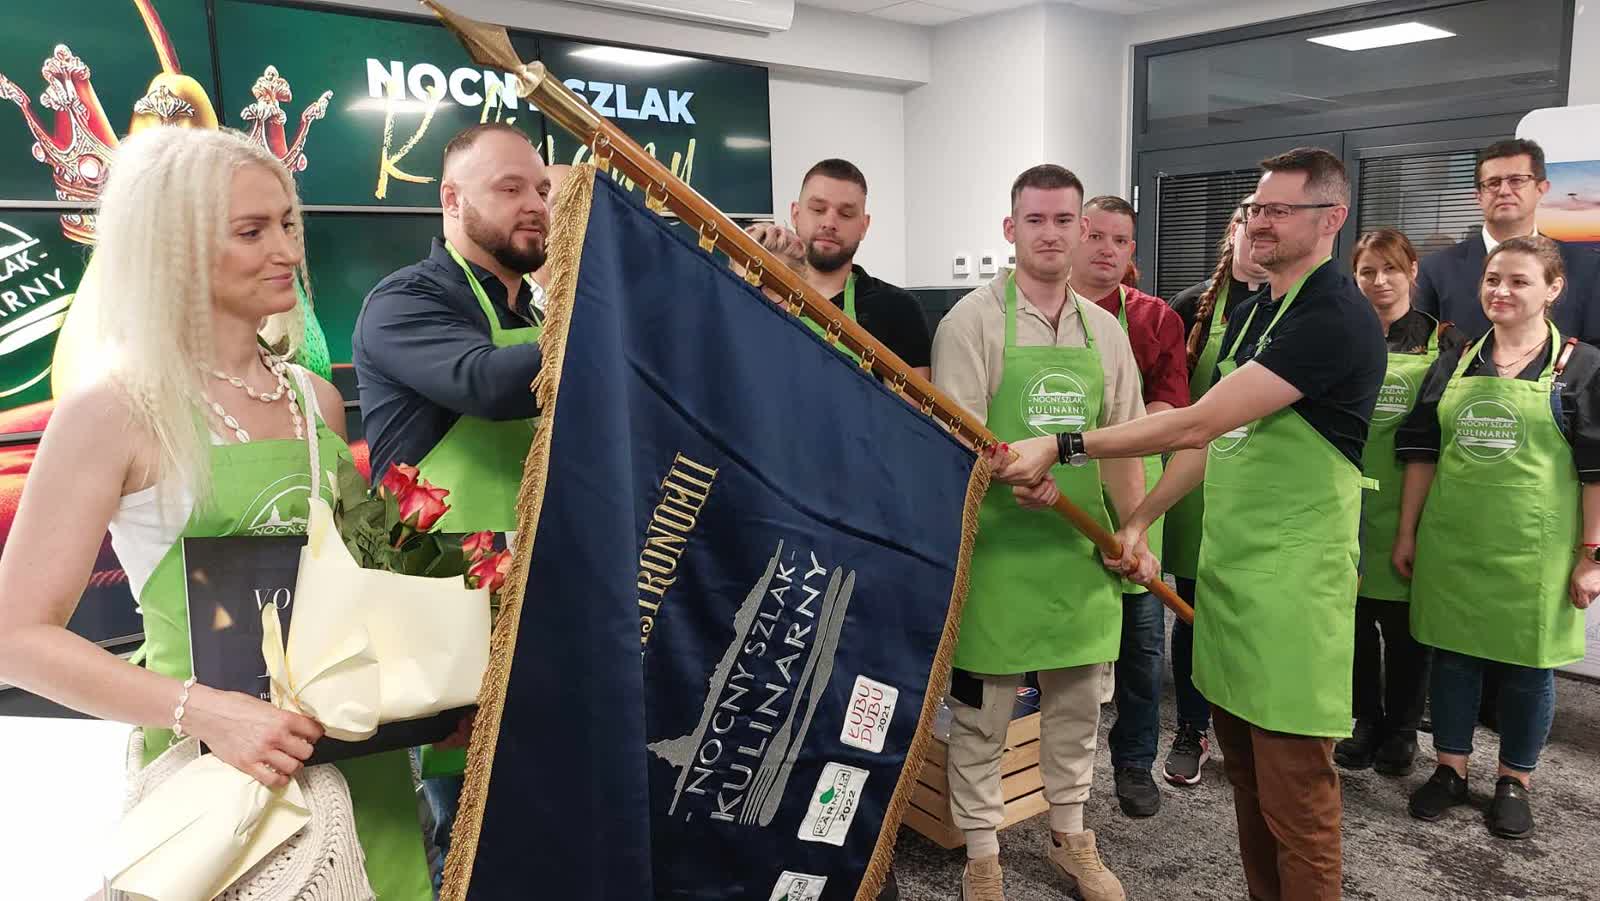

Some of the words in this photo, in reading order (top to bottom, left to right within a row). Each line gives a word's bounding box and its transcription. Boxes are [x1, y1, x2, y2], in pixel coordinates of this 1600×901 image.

[366, 58, 541, 112] NOCN
[1028, 405, 1086, 415] KULINARNY
[1457, 429, 1518, 439] KULINARNY
[685, 661, 755, 797] NOCNY
[744, 561, 796, 657] SZLAK
[710, 550, 827, 823] KULINARNY
[861, 687, 884, 744] DUBU
[877, 704, 891, 732] 2021
[838, 790, 856, 821] 2022
